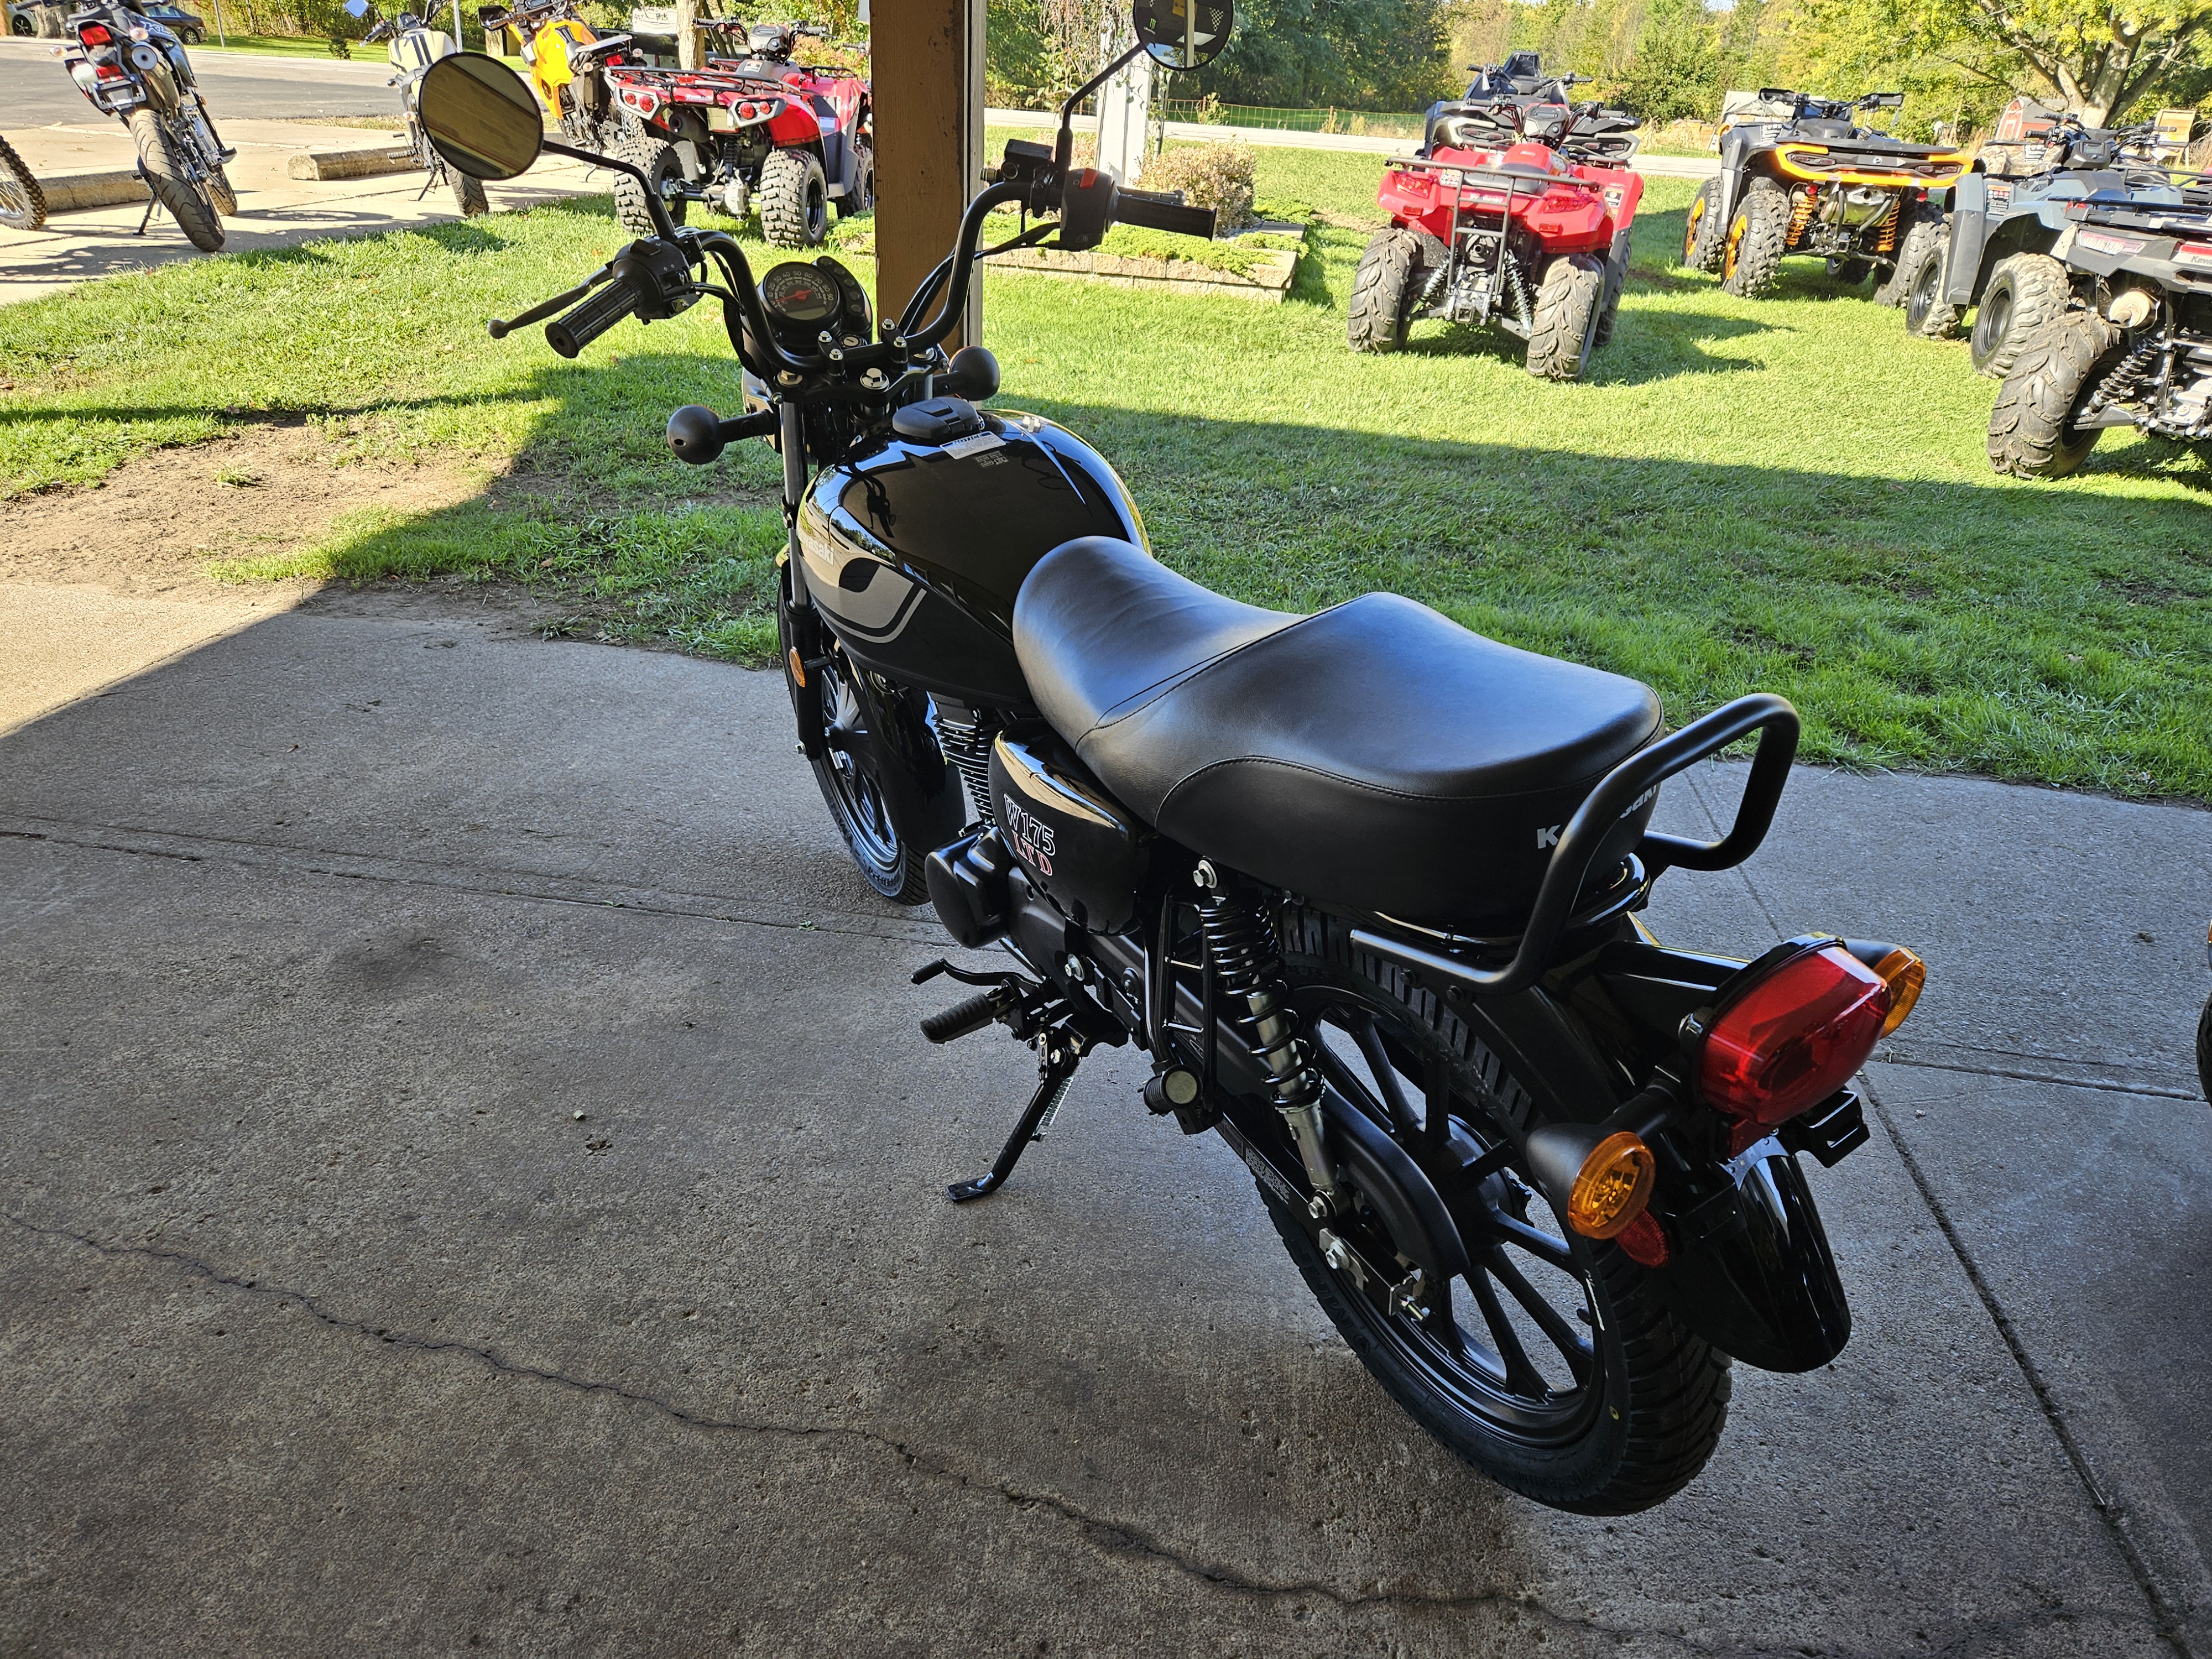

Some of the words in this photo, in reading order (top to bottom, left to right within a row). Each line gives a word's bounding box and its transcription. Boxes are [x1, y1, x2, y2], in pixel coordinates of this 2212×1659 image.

[953, 434, 982, 445] NOTICE
[1004, 793, 1056, 856] W175
[1011, 829, 1053, 876] LTD
